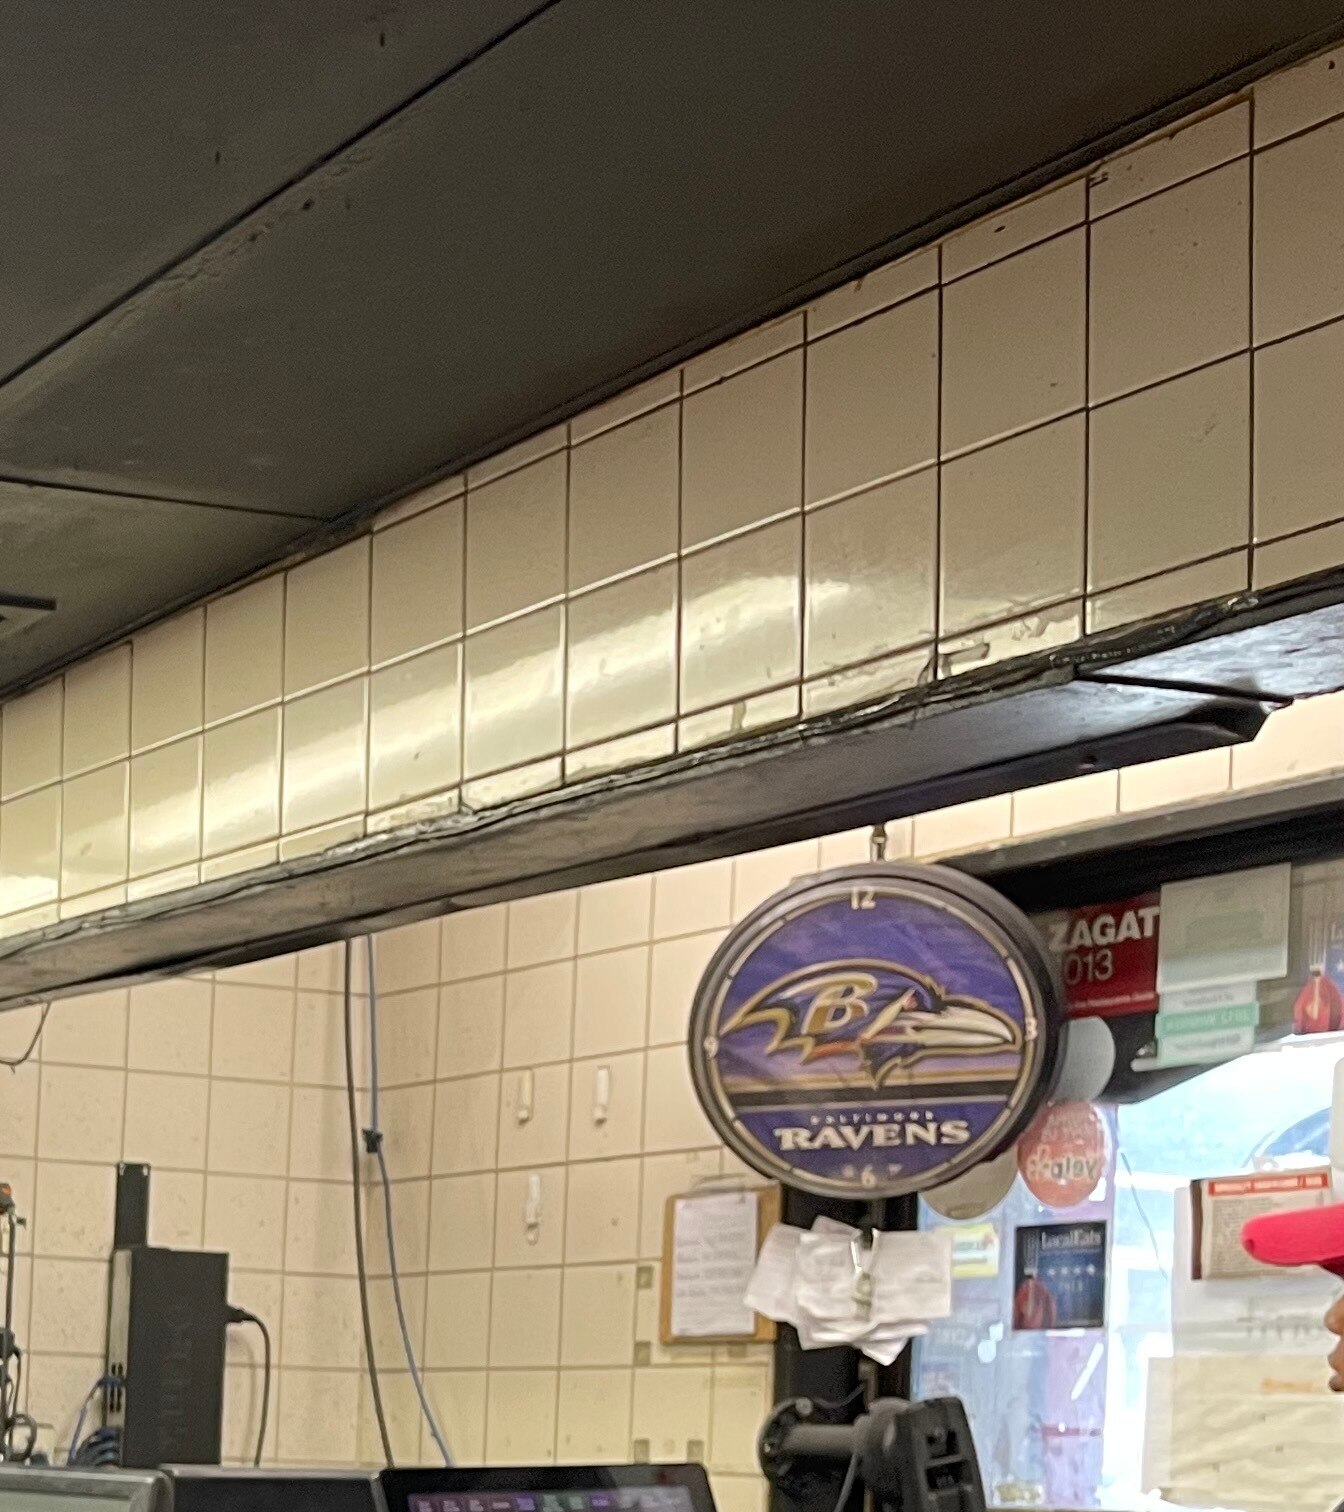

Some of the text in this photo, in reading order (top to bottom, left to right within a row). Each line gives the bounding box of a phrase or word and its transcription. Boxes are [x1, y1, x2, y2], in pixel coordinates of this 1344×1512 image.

[850, 885, 876, 910] 12
[1046, 906, 1161, 951] ZAGAT
[1063, 948, 1113, 987] 013
[772, 1119, 971, 1152] RAVENS
